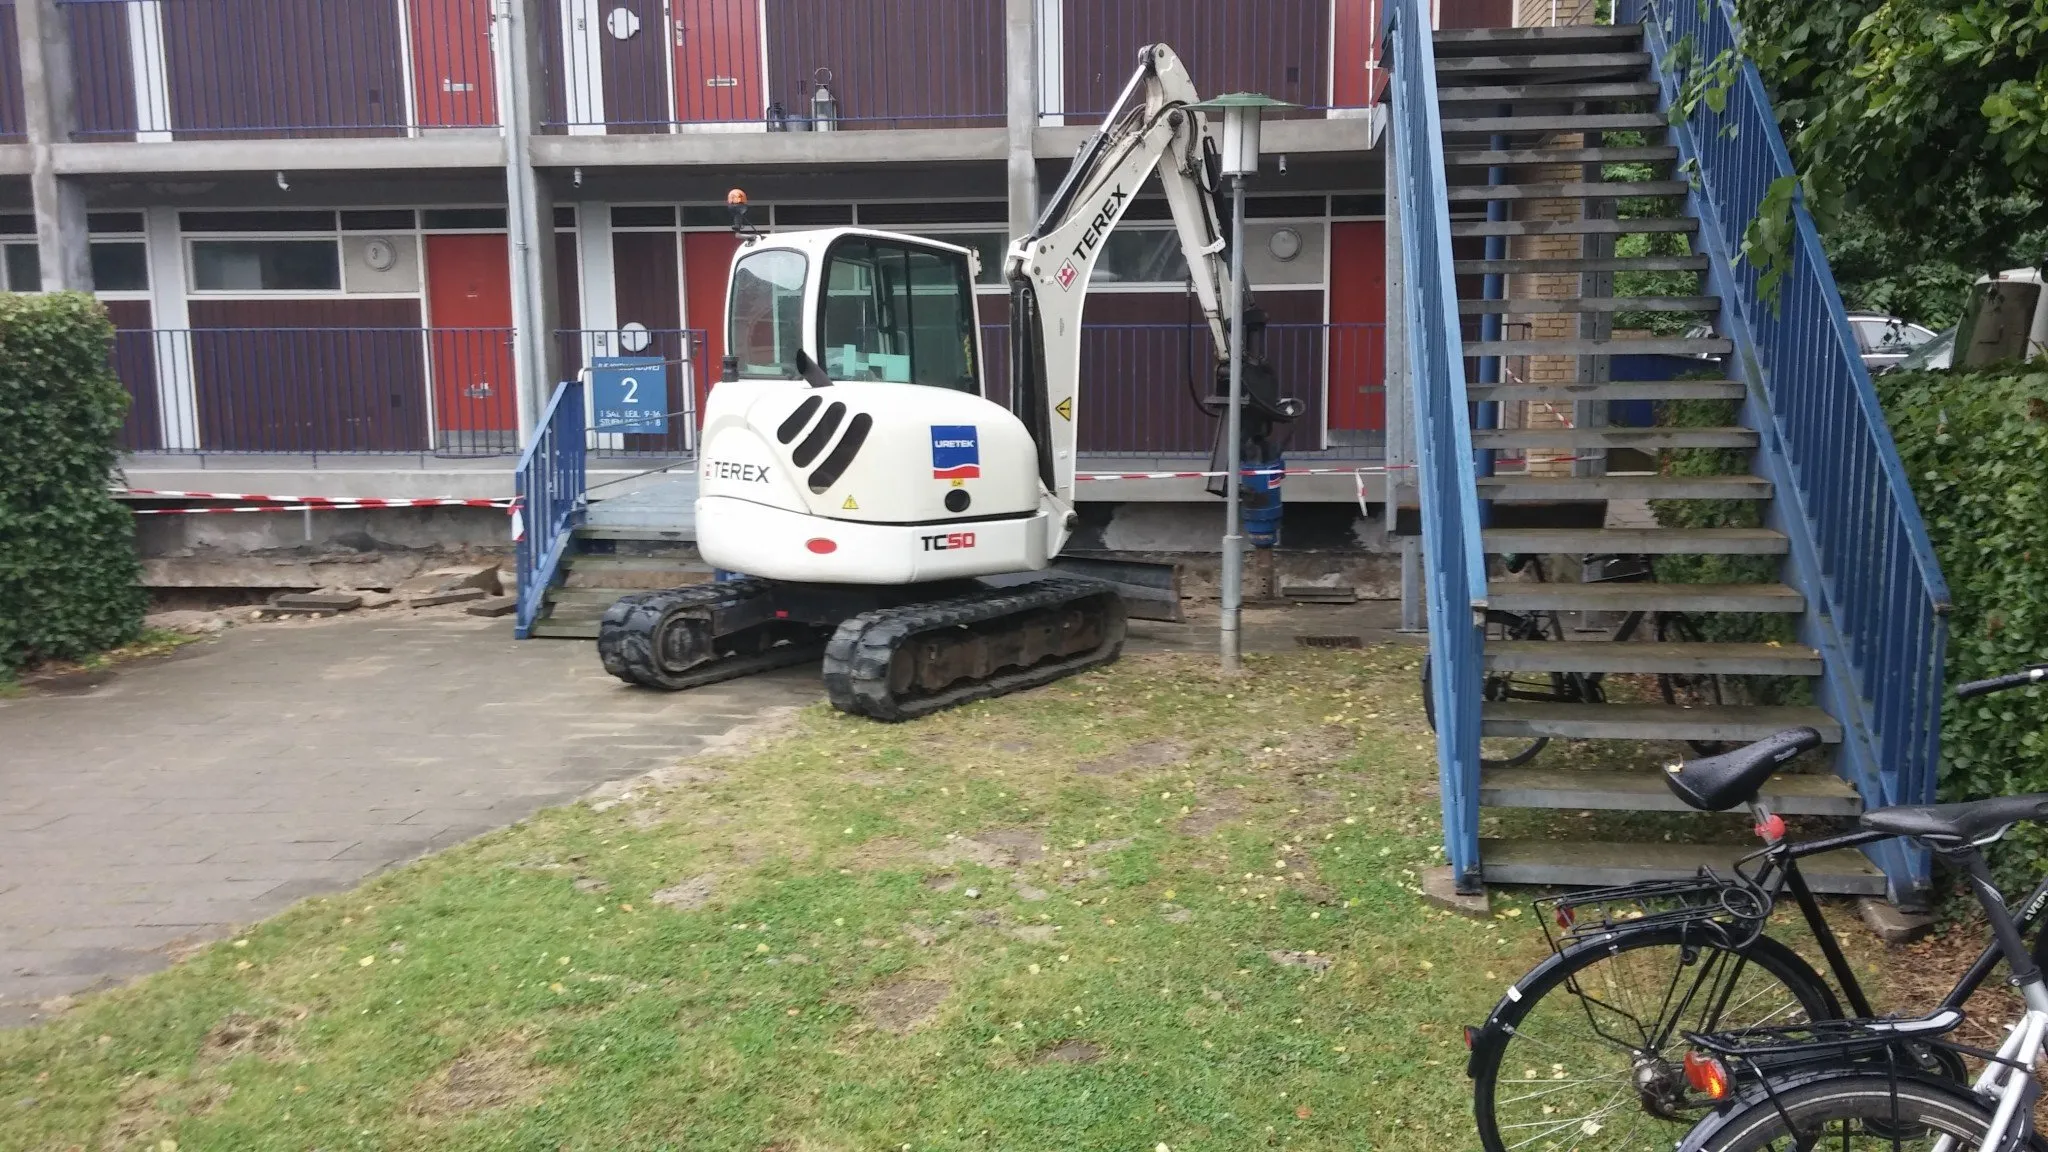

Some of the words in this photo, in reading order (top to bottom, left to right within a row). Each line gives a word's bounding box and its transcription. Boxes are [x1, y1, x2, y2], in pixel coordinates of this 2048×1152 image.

[1071, 182, 1129, 262] TEREX
[620, 377, 639, 403] 2
[934, 440, 975, 448] URETEK
[714, 461, 771, 484] TEREX
[921, 532, 976, 552] TC50
